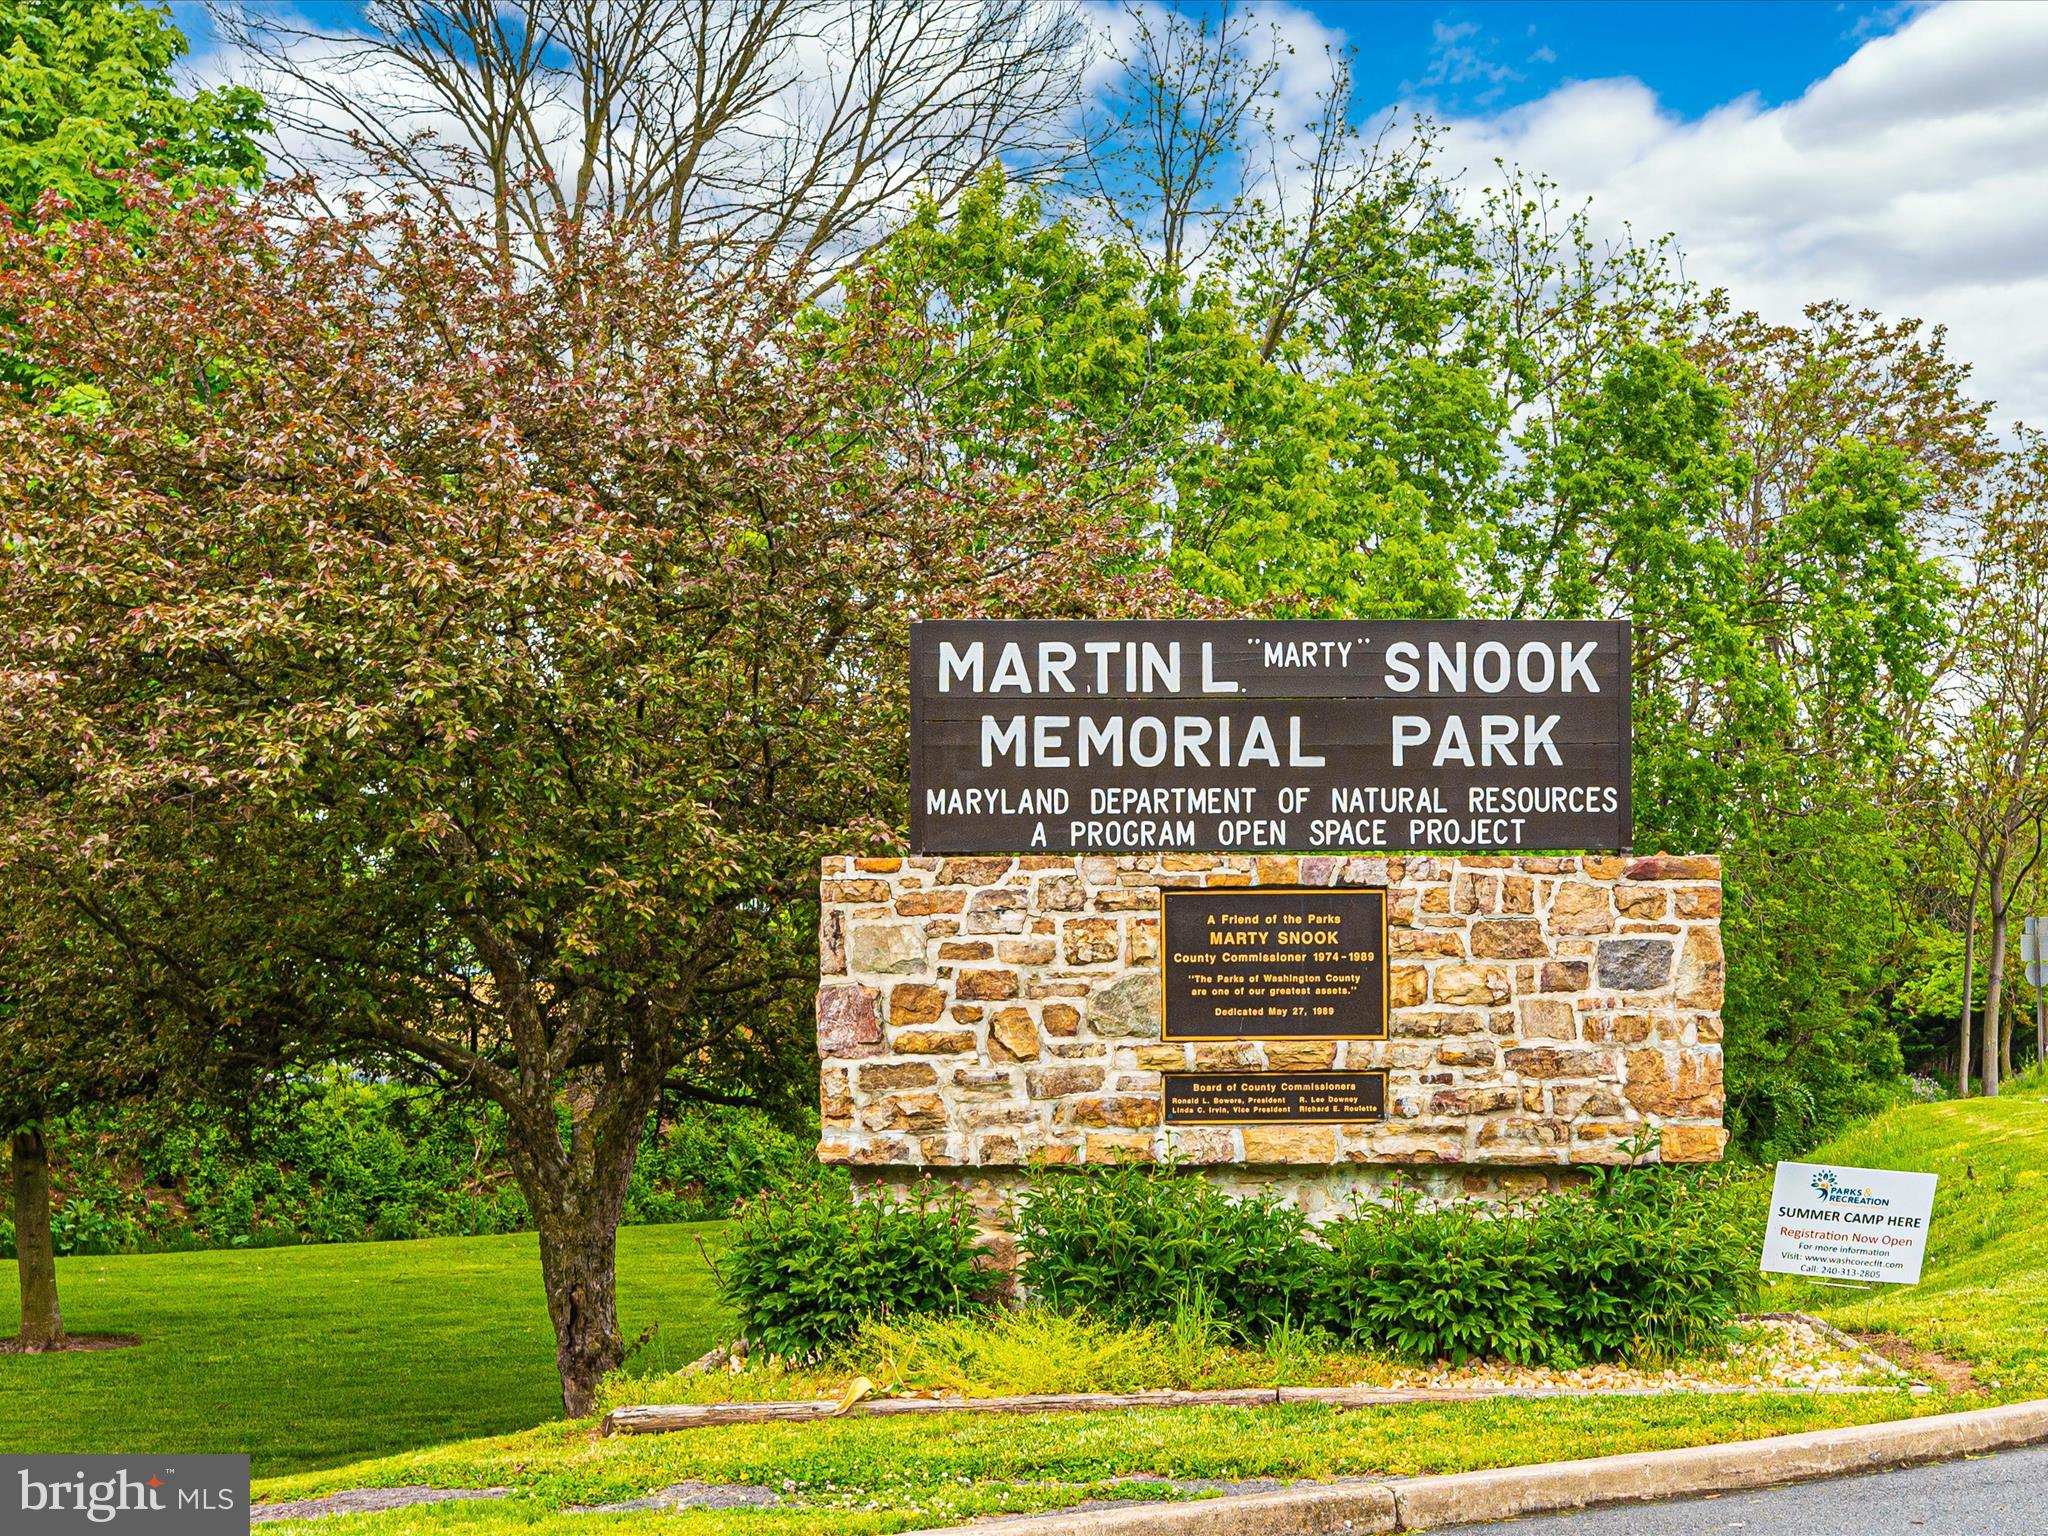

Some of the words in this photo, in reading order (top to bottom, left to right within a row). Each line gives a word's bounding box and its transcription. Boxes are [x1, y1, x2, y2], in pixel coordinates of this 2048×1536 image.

[938, 641, 1181, 694] MARTIN
[1384, 641, 1601, 694] SNOOK
[980, 714, 1326, 768] MEMORIAL
[1391, 714, 1563, 766] PARK
[926, 788, 1070, 815] MARYLAND
[1090, 787, 1257, 815] DEPARTMENT
[1278, 787, 1311, 814] OF
[1331, 787, 1449, 814] NATURAL
[1468, 786, 1619, 813] RESOURCES
[1030, 821, 1048, 848] A
[1070, 821, 1196, 847] PROGRAM
[1217, 819, 1287, 846] OPEN
[1308, 819, 1388, 846] SPACE
[1409, 818, 1526, 845] PROJECT
[1207, 915, 1216, 925] A
[1221, 914, 1259, 924] Friend
[1265, 914, 1277, 924] of
[1283, 914, 1302, 924] the
[1308, 914, 1341, 924] Parks
[1209, 931, 1269, 945] MARTY
[1277, 931, 1339, 945] SNOOK
[1173, 953, 1216, 965] County
[1222, 952, 1307, 962] Commissioner
[1217, 974, 1245, 983] Parks
[1249, 974, 1259, 983] of
[1263, 974, 1321, 984] Washington
[1325, 974, 1361, 984] County
[1191, 987, 1207, 996] are
[1212, 987, 1230, 995] one
[1234, 987, 1245, 995] of
[1249, 987, 1265, 995] our
[1270, 987, 1311, 997] greatest
[1215, 1007, 1264, 1016] Dedicated
[1268, 1007, 1288, 1017] May
[1292, 1007, 1307, 1016] 27,
[1312, 1007, 1335, 1016] 1989
[1193, 1083, 1222, 1092] Board
[1226, 1083, 1237, 1092] of
[1241, 1083, 1277, 1093] County
[1281, 1082, 1356, 1091] Commissioners
[1172, 1097, 1199, 1105] Ronald
[1299, 1096, 1308, 1104] R.
[1328, 1096, 1358, 1104] Downey
[1172, 1106, 1194, 1114] Linda
[1209, 1106, 1229, 1114] Irvin,
[1299, 1105, 1330, 1113] Richard
[1830, 1188, 1862, 1196] PARKS
[1864, 1188, 1872, 1197] &
[1829, 1195, 1889, 1206] RECREATION
[1778, 1206, 1840, 1222] SUMMER
[1844, 1212, 1884, 1225] CAMP
[1888, 1218, 1922, 1228] HERE
[1780, 1226, 1849, 1241] Registration
[1852, 1233, 1879, 1244] Now
[1882, 1235, 1913, 1247] Open
[1798, 1242, 1813, 1250] For
[1814, 1245, 1838, 1253] more
[1840, 1246, 1890, 1257] information
[1781, 1252, 1802, 1261] Visit:
[1800, 1265, 1819, 1273] Call:
[1821, 1267, 1881, 1278] 240-313-2805
